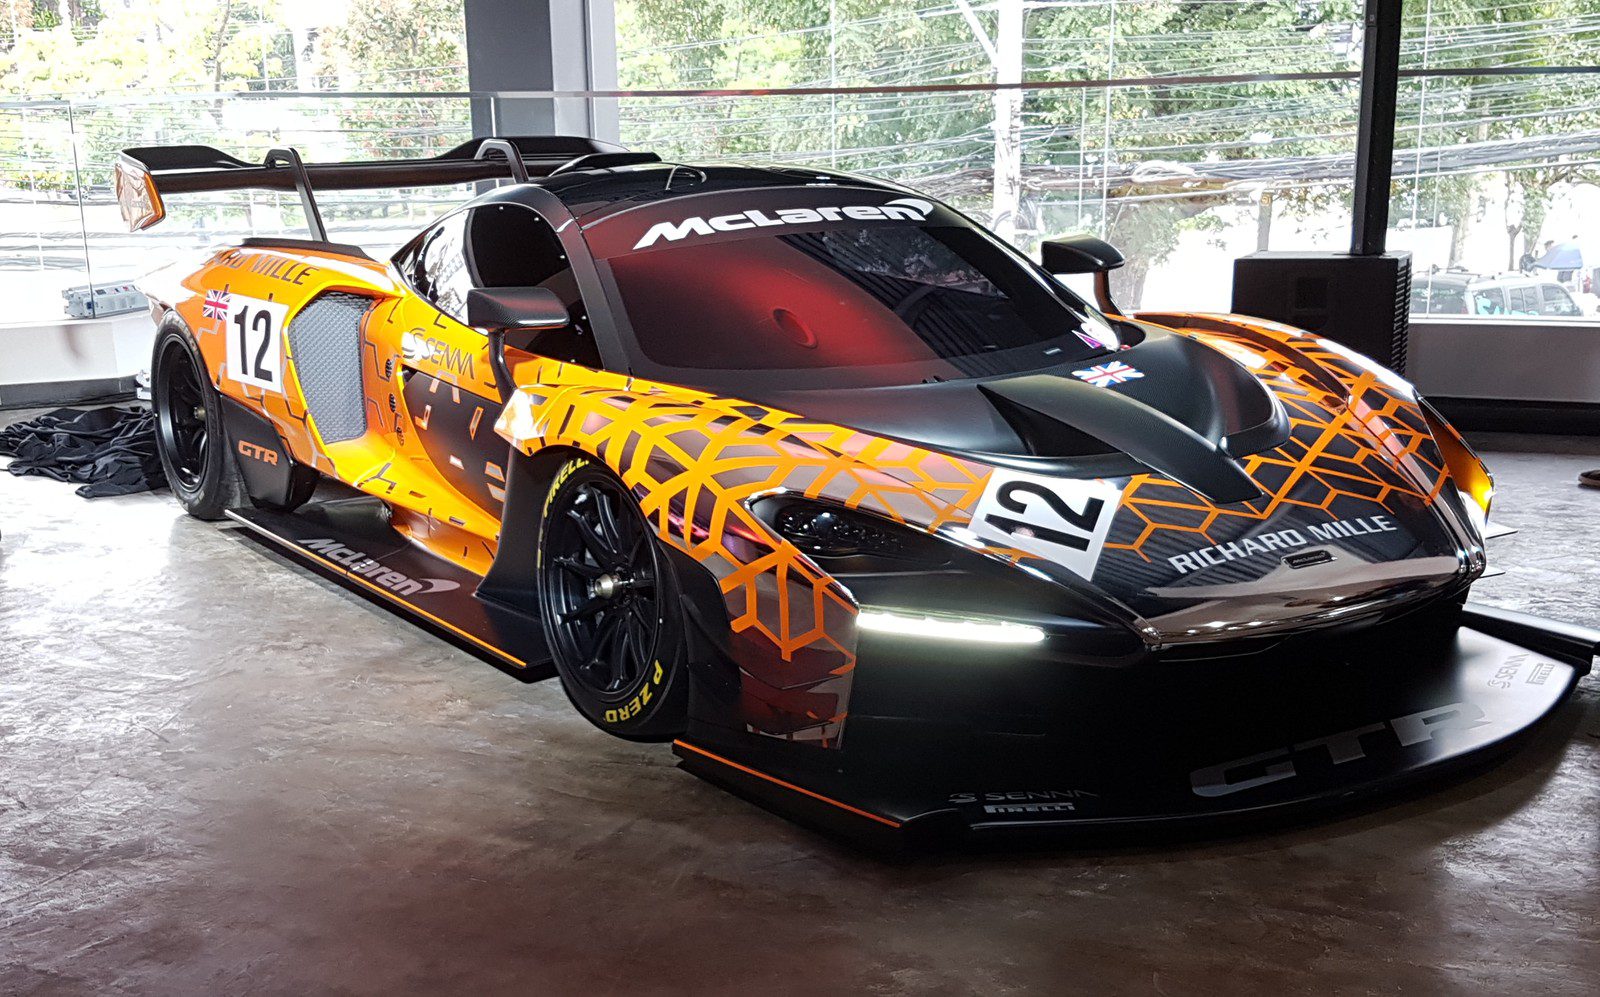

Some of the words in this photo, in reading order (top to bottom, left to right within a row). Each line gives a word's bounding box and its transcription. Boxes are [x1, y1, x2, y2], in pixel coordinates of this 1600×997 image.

[633, 199, 934, 250] McLaren
[250, 254, 320, 286] MILLE
[234, 305, 273, 383] 12
[425, 337, 475, 380] SENNA
[238, 440, 278, 466] GTR
[543, 458, 590, 518] PIRELL
[984, 480, 1105, 552] 12
[297, 538, 423, 596] McLaren
[1168, 529, 1307, 574] RICHARD
[1307, 515, 1398, 541] MILLE
[653, 660, 664, 685] P
[605, 682, 653, 723] ZERO
[1190, 702, 1492, 797] GTR
[985, 789, 1099, 801] SENNA
